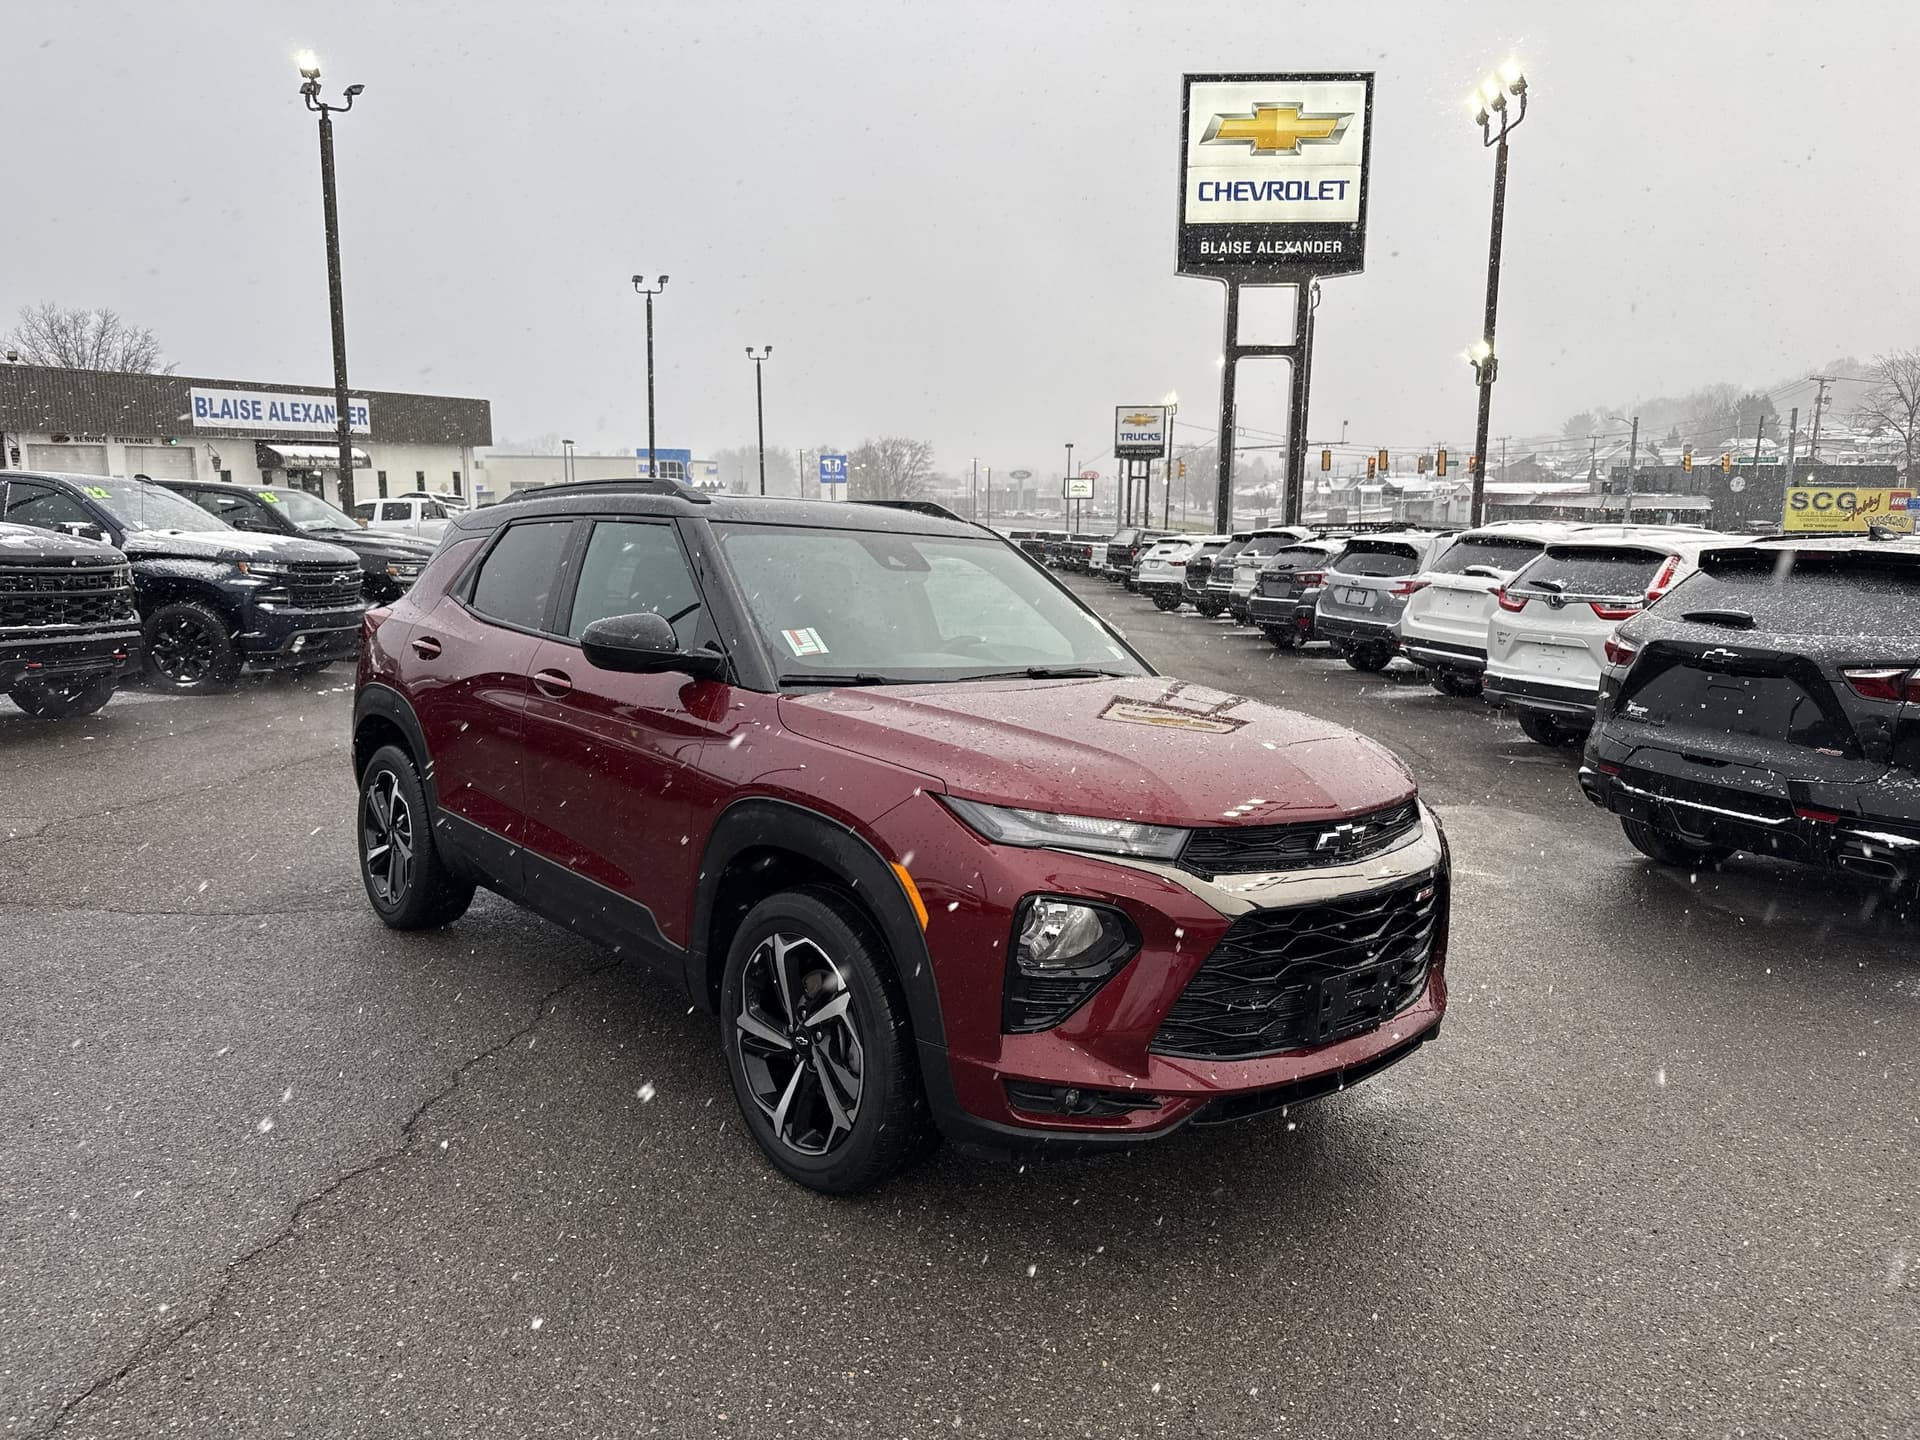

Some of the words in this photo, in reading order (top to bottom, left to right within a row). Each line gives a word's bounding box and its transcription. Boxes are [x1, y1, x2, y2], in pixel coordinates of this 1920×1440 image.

[1198, 180, 1351, 202] CHEVROLET
[1200, 240, 1251, 254] BLAISE
[1256, 240, 1343, 254] ALEXANDER
[194, 396, 263, 420] BLAISE
[268, 401, 369, 426] ALEXANER
[114, 437, 154, 445] ENTRANCE
[1120, 432, 1161, 441] TRUCKS
[1790, 491, 1857, 511] SCG
